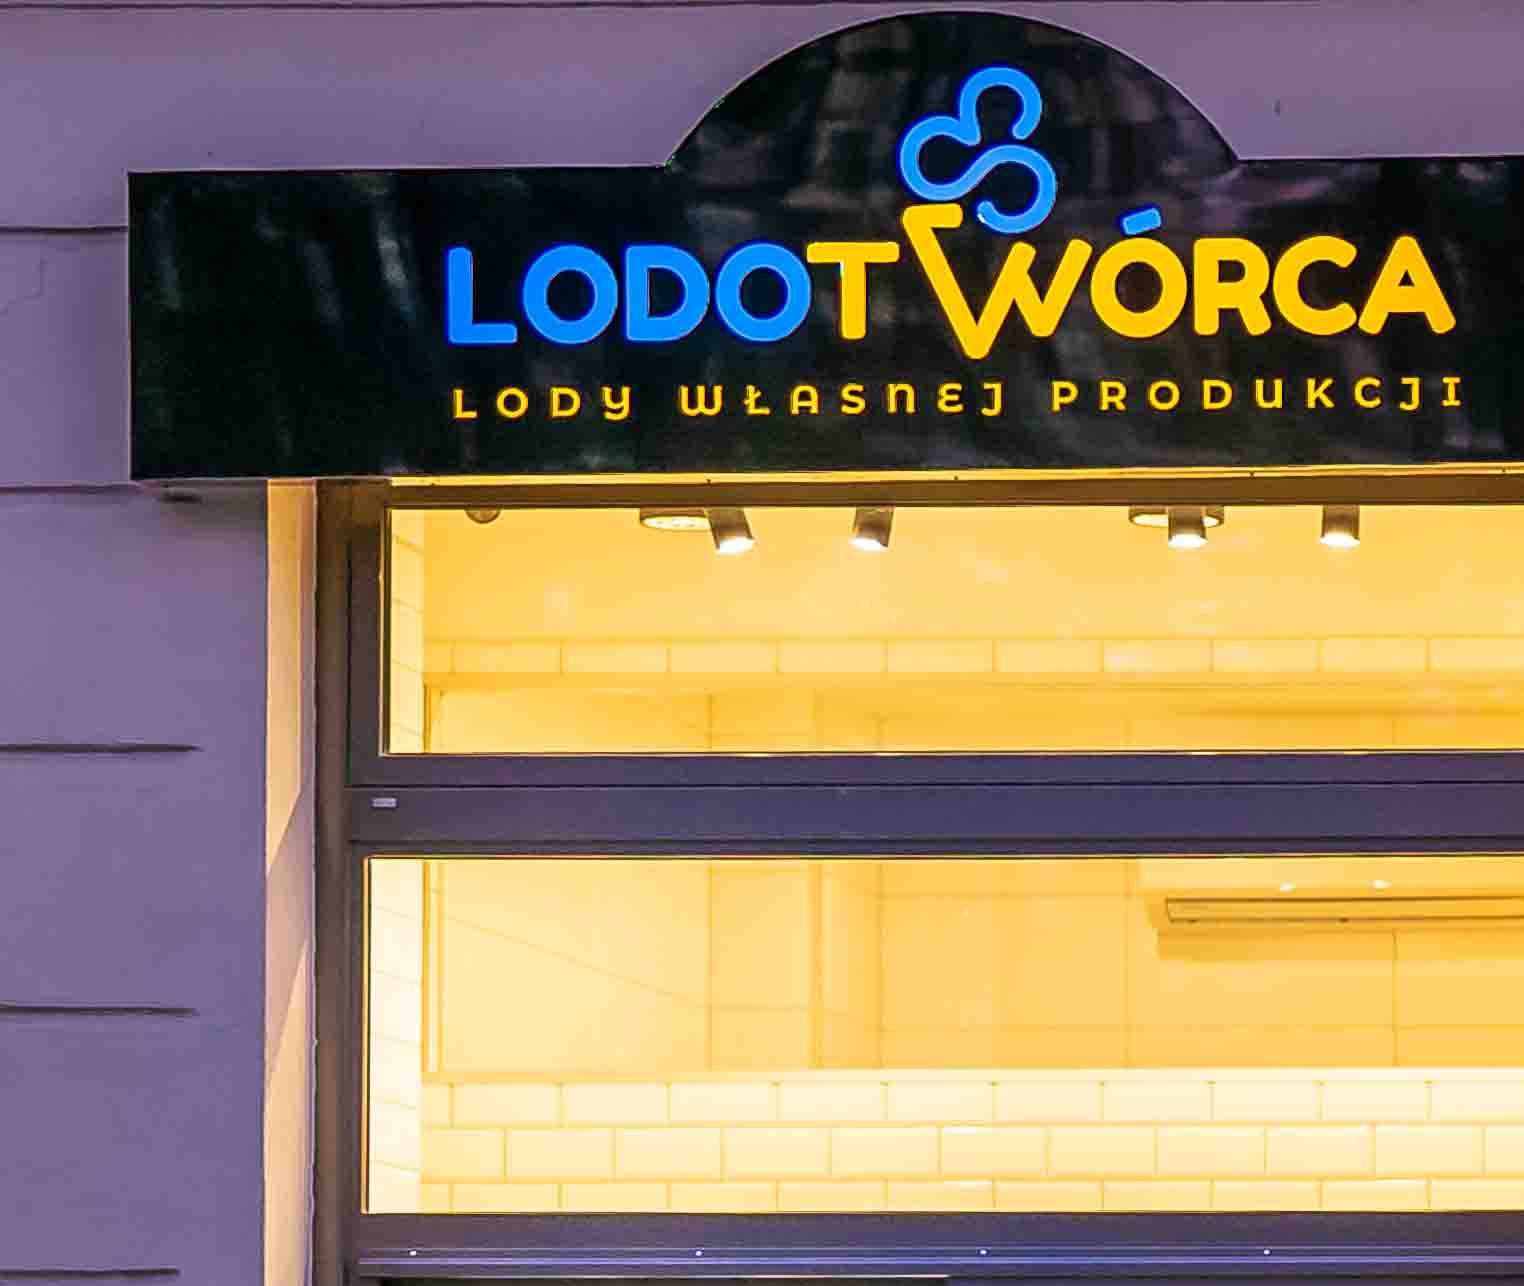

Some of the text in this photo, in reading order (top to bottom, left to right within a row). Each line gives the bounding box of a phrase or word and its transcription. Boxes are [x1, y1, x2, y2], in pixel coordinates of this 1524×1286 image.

[446, 203, 1457, 360] LODOTWÓRCA
[452, 375, 1463, 421] LODY WŁASNEJ PRODUKCJI
